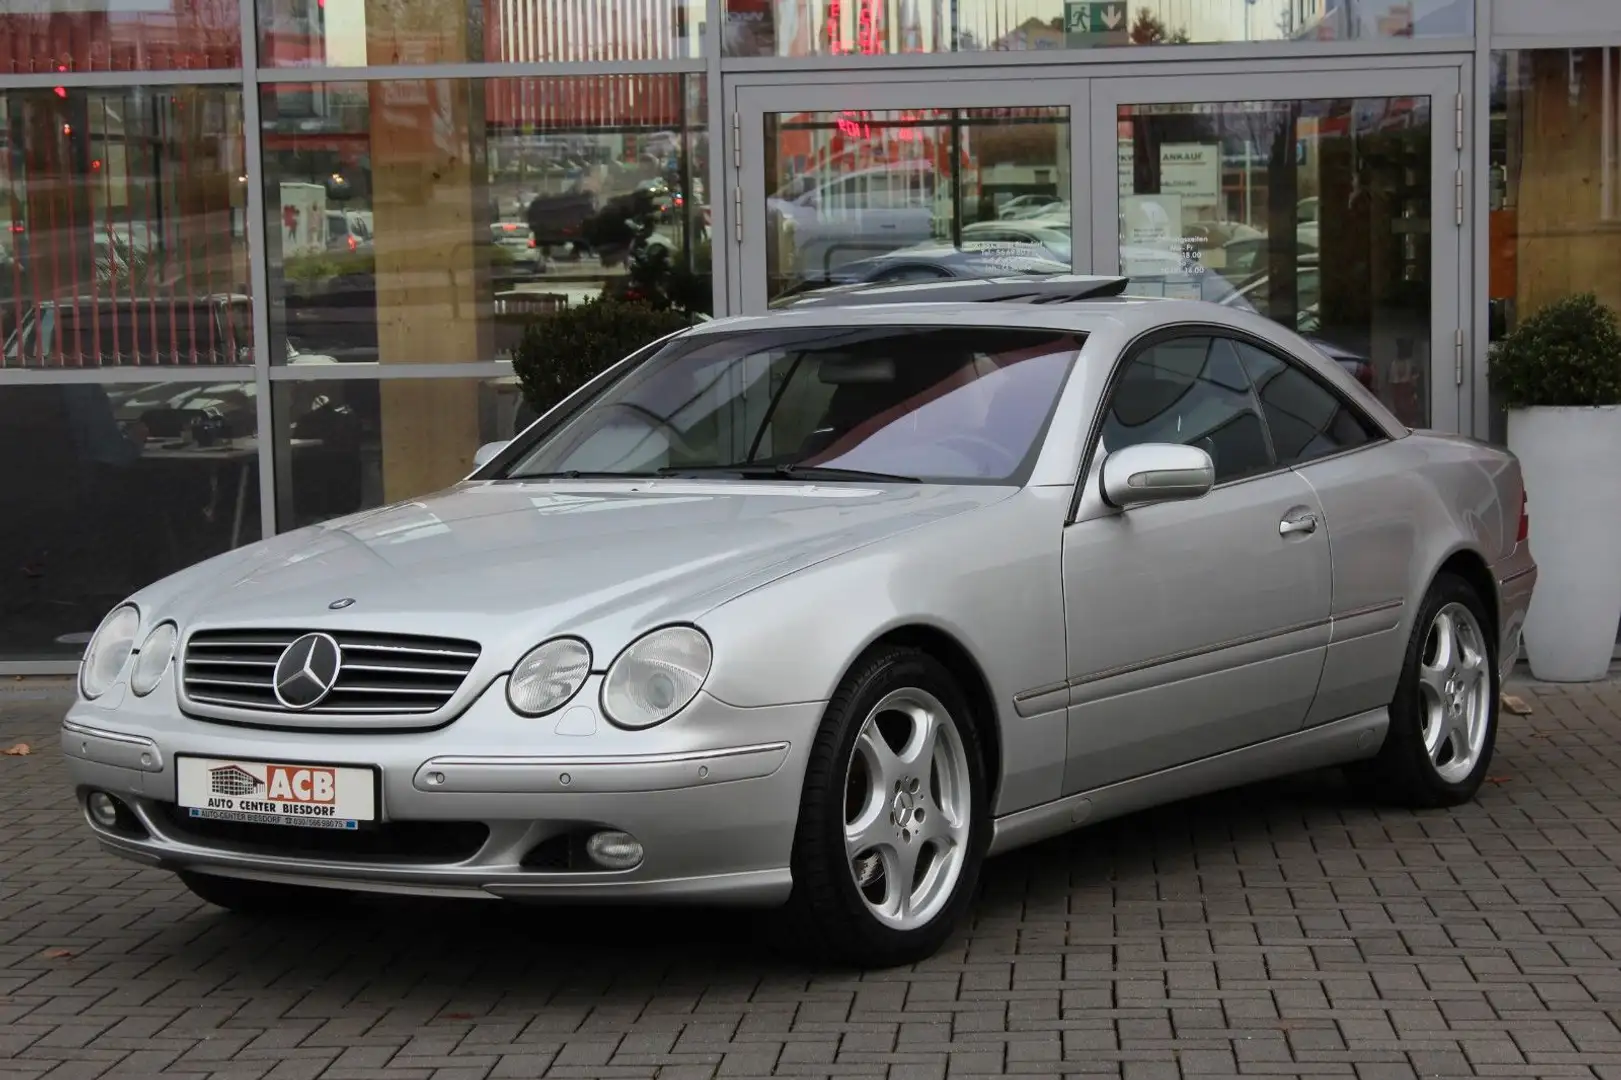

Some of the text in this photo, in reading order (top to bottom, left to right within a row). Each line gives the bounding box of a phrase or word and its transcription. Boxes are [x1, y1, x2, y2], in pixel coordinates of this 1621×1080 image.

[1163, 151, 1203, 161] ANKAUF
[269, 768, 335, 802] ACB
[208, 798, 335, 816] AUTO CENTER BIESDORF
[248, 814, 281, 824] BIESDORF
